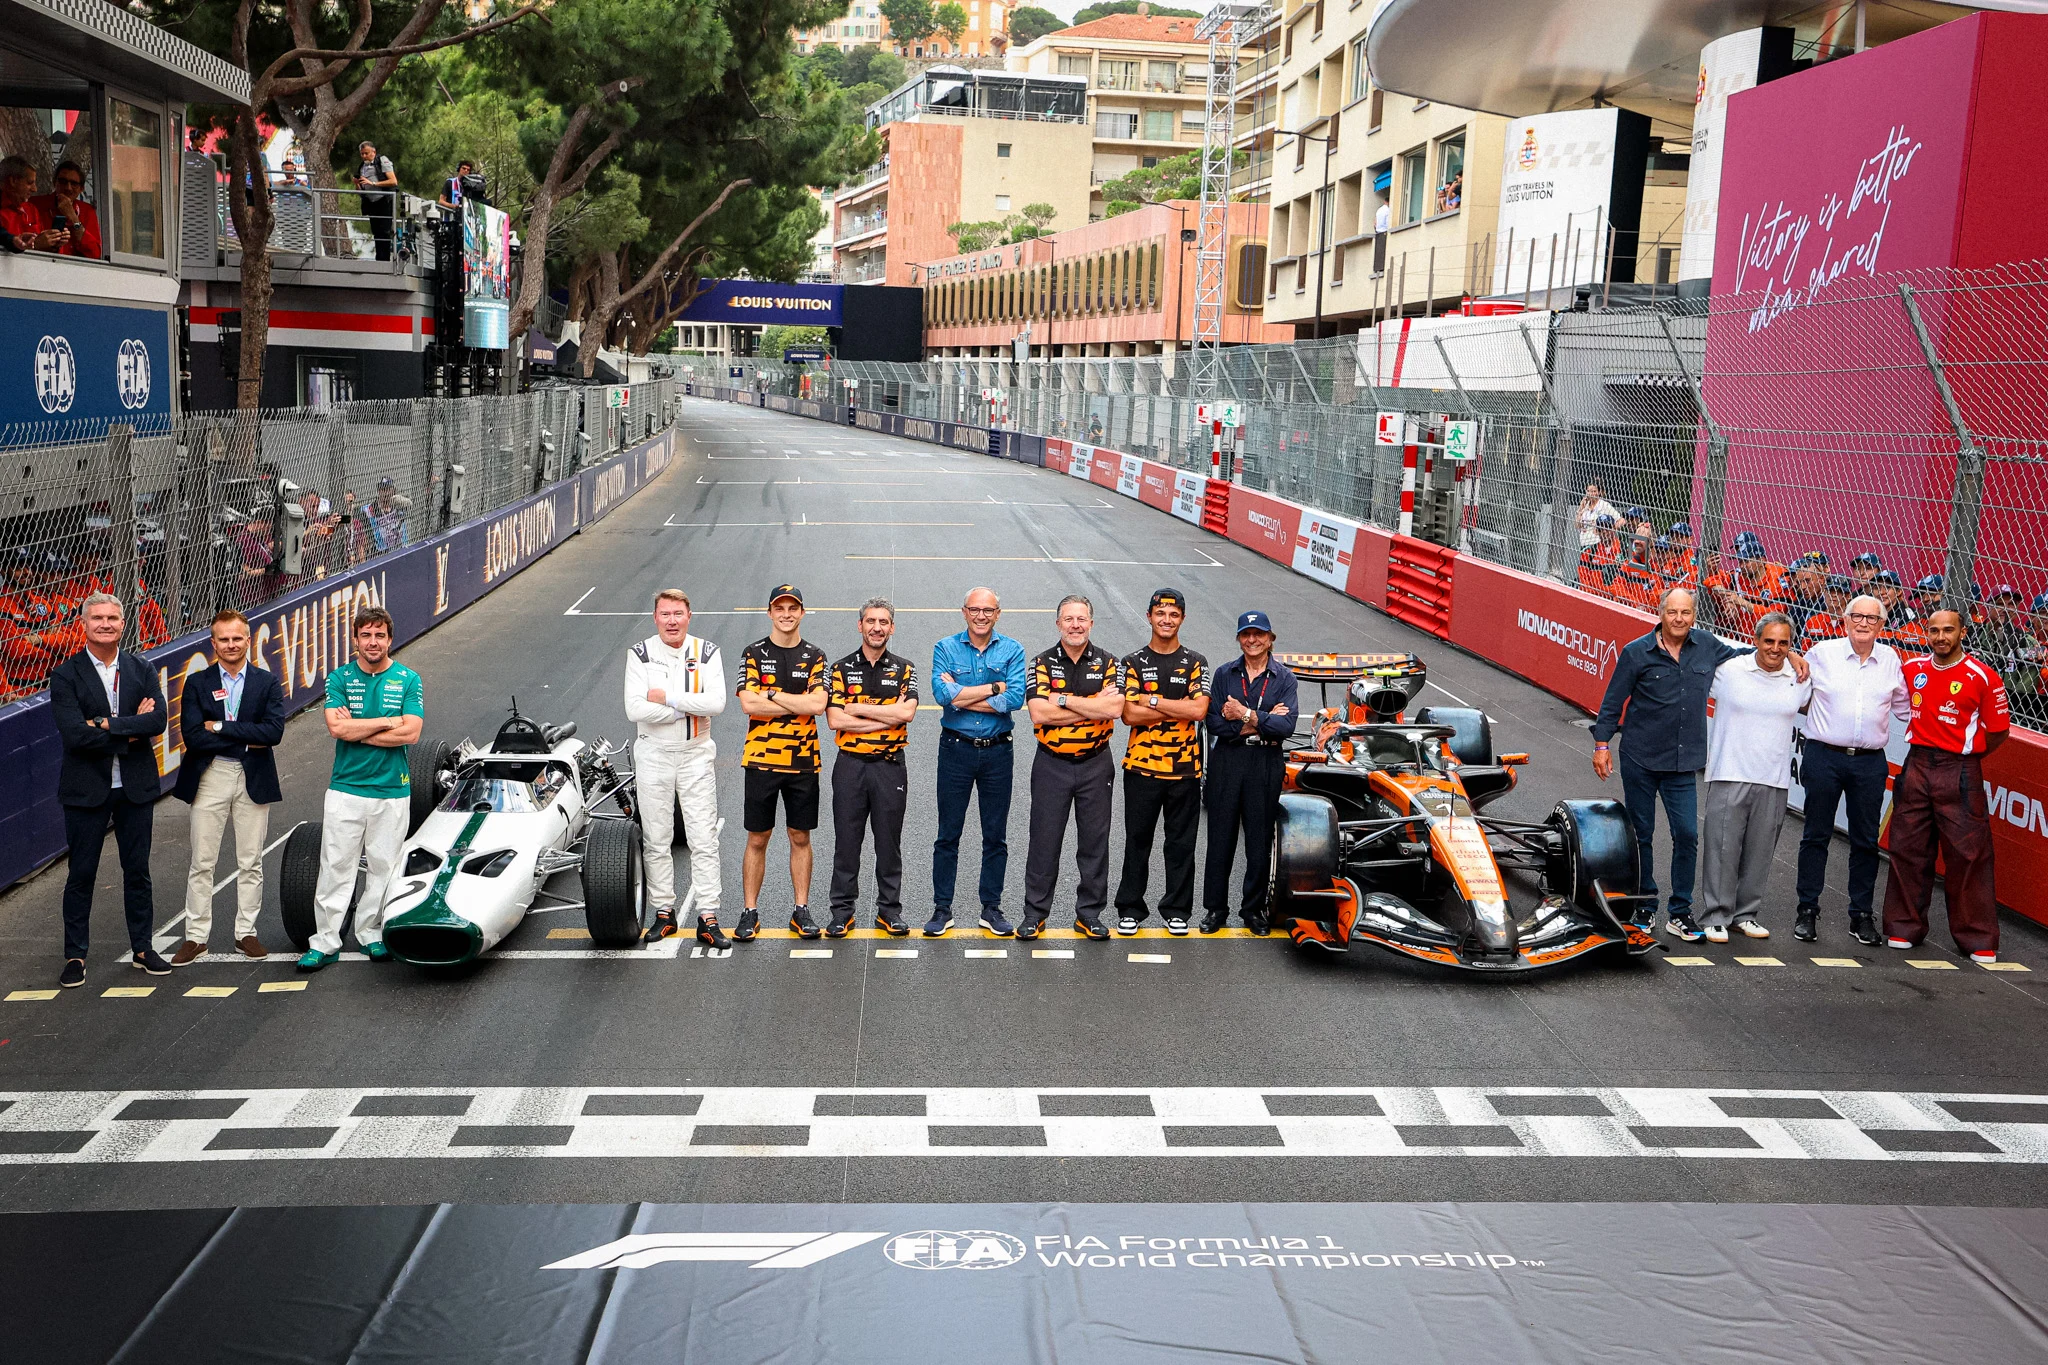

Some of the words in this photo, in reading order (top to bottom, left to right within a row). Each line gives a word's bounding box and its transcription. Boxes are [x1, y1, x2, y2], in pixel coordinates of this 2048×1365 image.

[1523, 181, 1545, 190] TRAVELS
[1546, 180, 1554, 189] IN
[1506, 192, 1519, 204] LOUIS
[1521, 189, 1553, 201] VUITTON
[1735, 200, 1811, 295] Victory
[1819, 192, 1843, 231] is
[1846, 124, 1921, 219] better
[1806, 199, 1891, 309] shared
[733, 295, 773, 309] LOUIS
[775, 297, 832, 311] VUITTON
[904, 418, 917, 437] LOUIS
[954, 426, 969, 447] LOUIS
[969, 429, 989, 451] VUITTON
[484, 513, 518, 583] LOUIS
[519, 493, 556, 561] VUITTON
[1567, 654, 1583, 670] SINCE
[1583, 660, 1598, 676] 1929
[1034, 1234, 1110, 1250] FIA
[1118, 1234, 1310, 1250] Formula
[1315, 1234, 1344, 1250] 1
[1037, 1251, 1177, 1268] World
